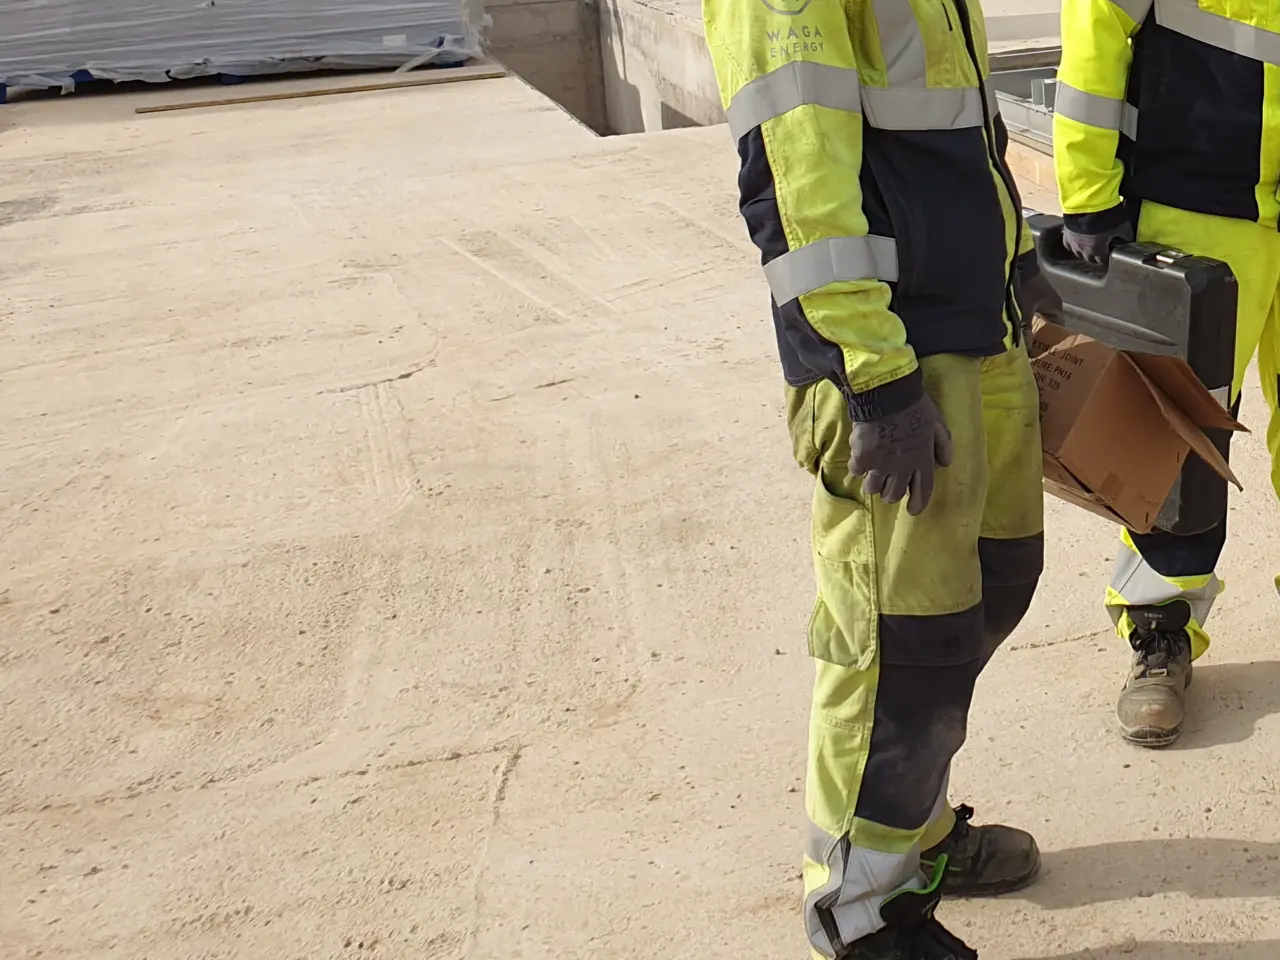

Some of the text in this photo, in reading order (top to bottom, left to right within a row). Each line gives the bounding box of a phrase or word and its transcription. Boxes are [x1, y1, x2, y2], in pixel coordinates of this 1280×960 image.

[767, 26, 823, 43] WAGA
[770, 41, 824, 58] ENERGY
[1060, 351, 1084, 367] JOINT
[1053, 365, 1073, 381] PN16
